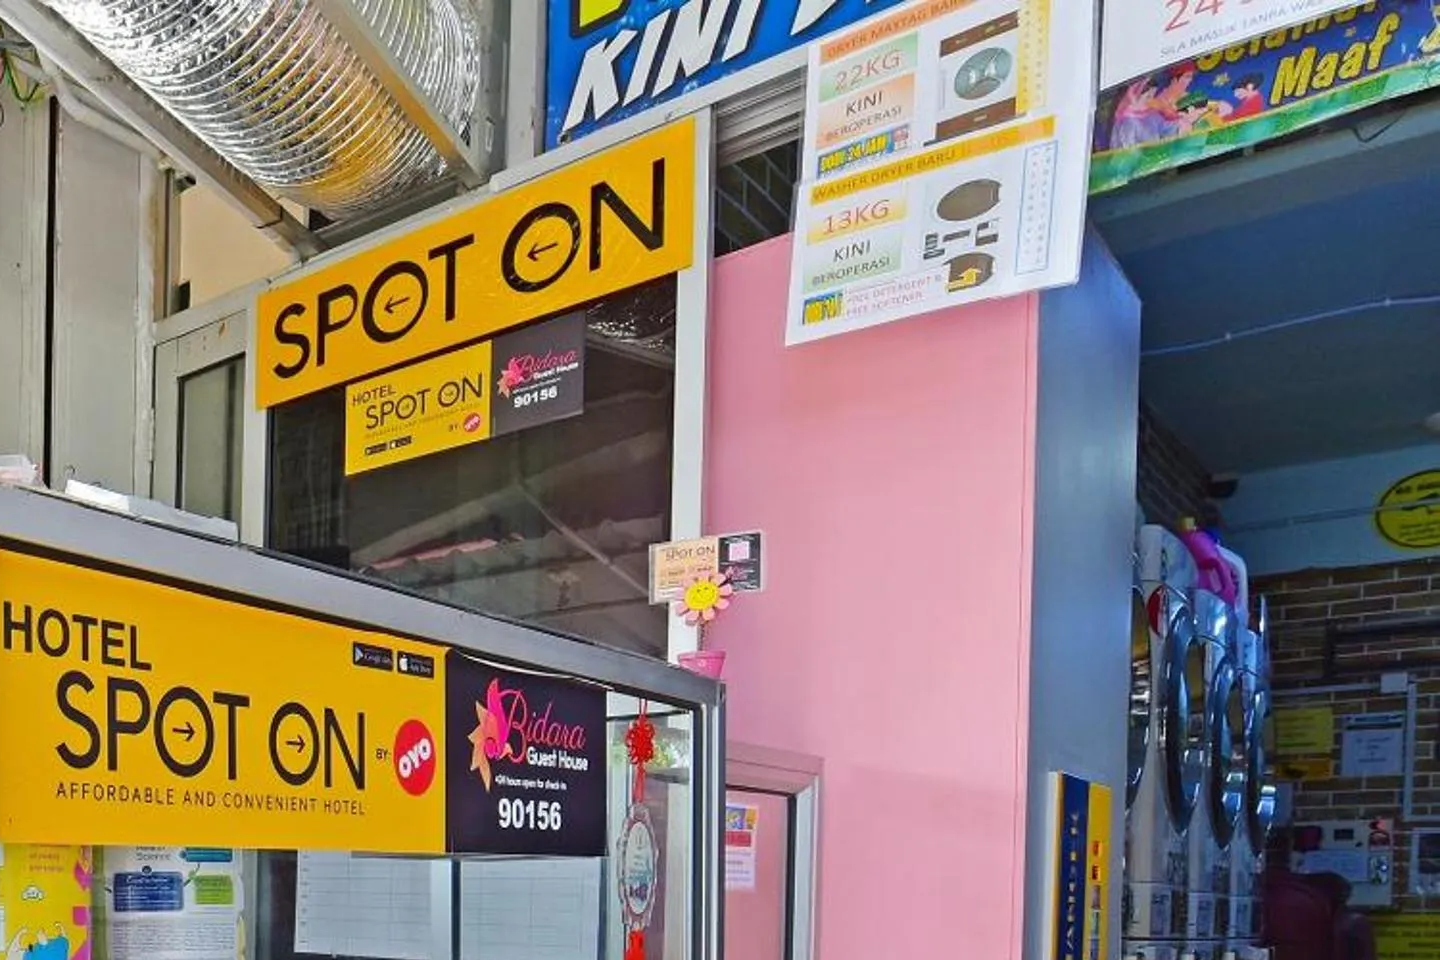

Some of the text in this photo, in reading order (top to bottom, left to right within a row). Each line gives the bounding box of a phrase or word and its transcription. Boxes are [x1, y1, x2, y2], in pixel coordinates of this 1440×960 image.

[561, 0, 762, 133] KINI
[834, 49, 902, 93] 22KG
[1269, 11, 1400, 105] Maaf
[825, 106, 902, 142] BEROPERASI
[845, 90, 883, 117] KINI
[813, 177, 868, 200] WASHER
[870, 162, 914, 185] DRYER
[917, 149, 956, 170] BARU
[823, 199, 891, 236] 13KG
[272, 157, 666, 380] SPOT ON
[812, 255, 891, 287] BEROPERASI
[833, 239, 872, 263] KINI
[352, 384, 396, 408] HOTEL
[365, 388, 431, 430] SPOT
[437, 372, 483, 408] ON
[3, 600, 152, 672] HOTEL
[55, 670, 366, 790] SPOT ON
[498, 689, 586, 763] Bidara
[398, 738, 432, 779] OYO
[526, 746, 589, 771] Guest House
[56, 782, 366, 816] AFFORDABLE AND CONVENIENT HOTEL
[498, 798, 562, 831] 90156
